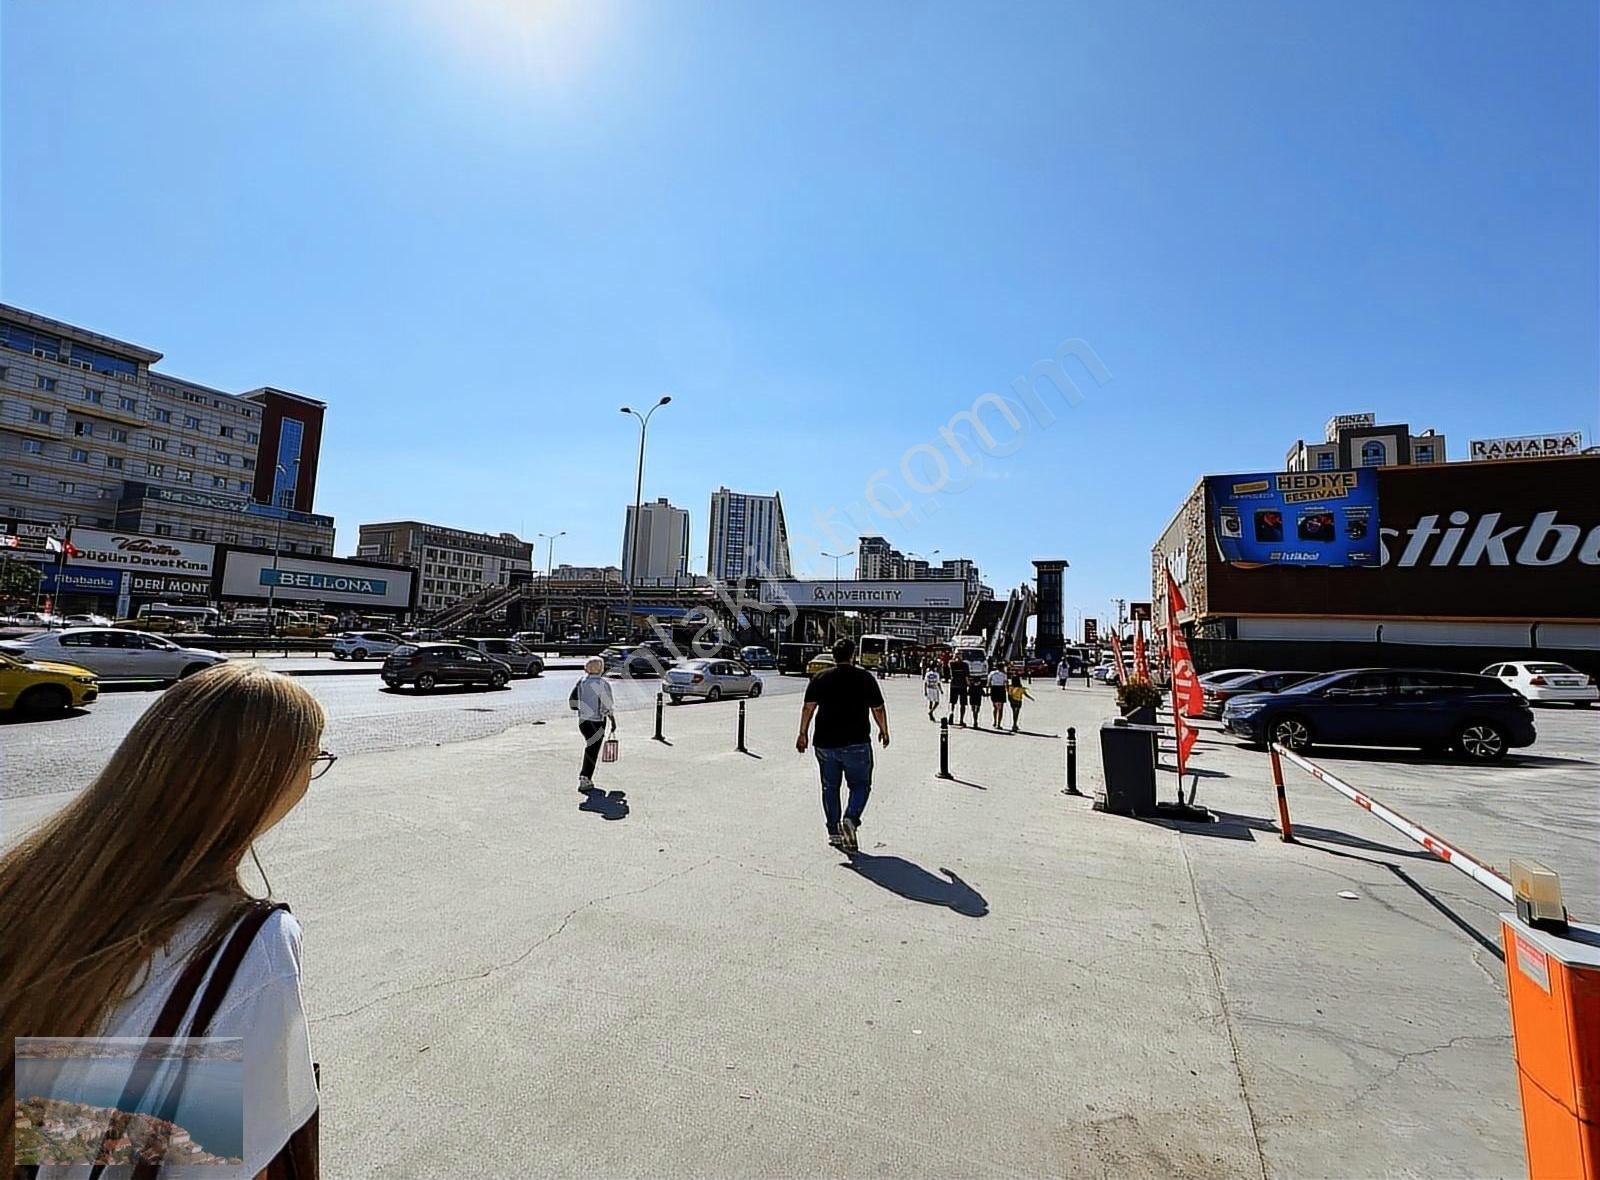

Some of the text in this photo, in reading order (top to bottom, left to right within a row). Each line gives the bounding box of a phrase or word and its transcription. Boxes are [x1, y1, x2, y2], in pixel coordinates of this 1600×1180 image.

[1472, 436, 1577, 456] RAMADA
[76, 549, 128, 564] Düğün
[130, 554, 174, 567] Davet
[168, 580, 210, 593] MONT
[280, 572, 373, 592] BELLONA
[827, 590, 902, 601] ADVERTCITY
